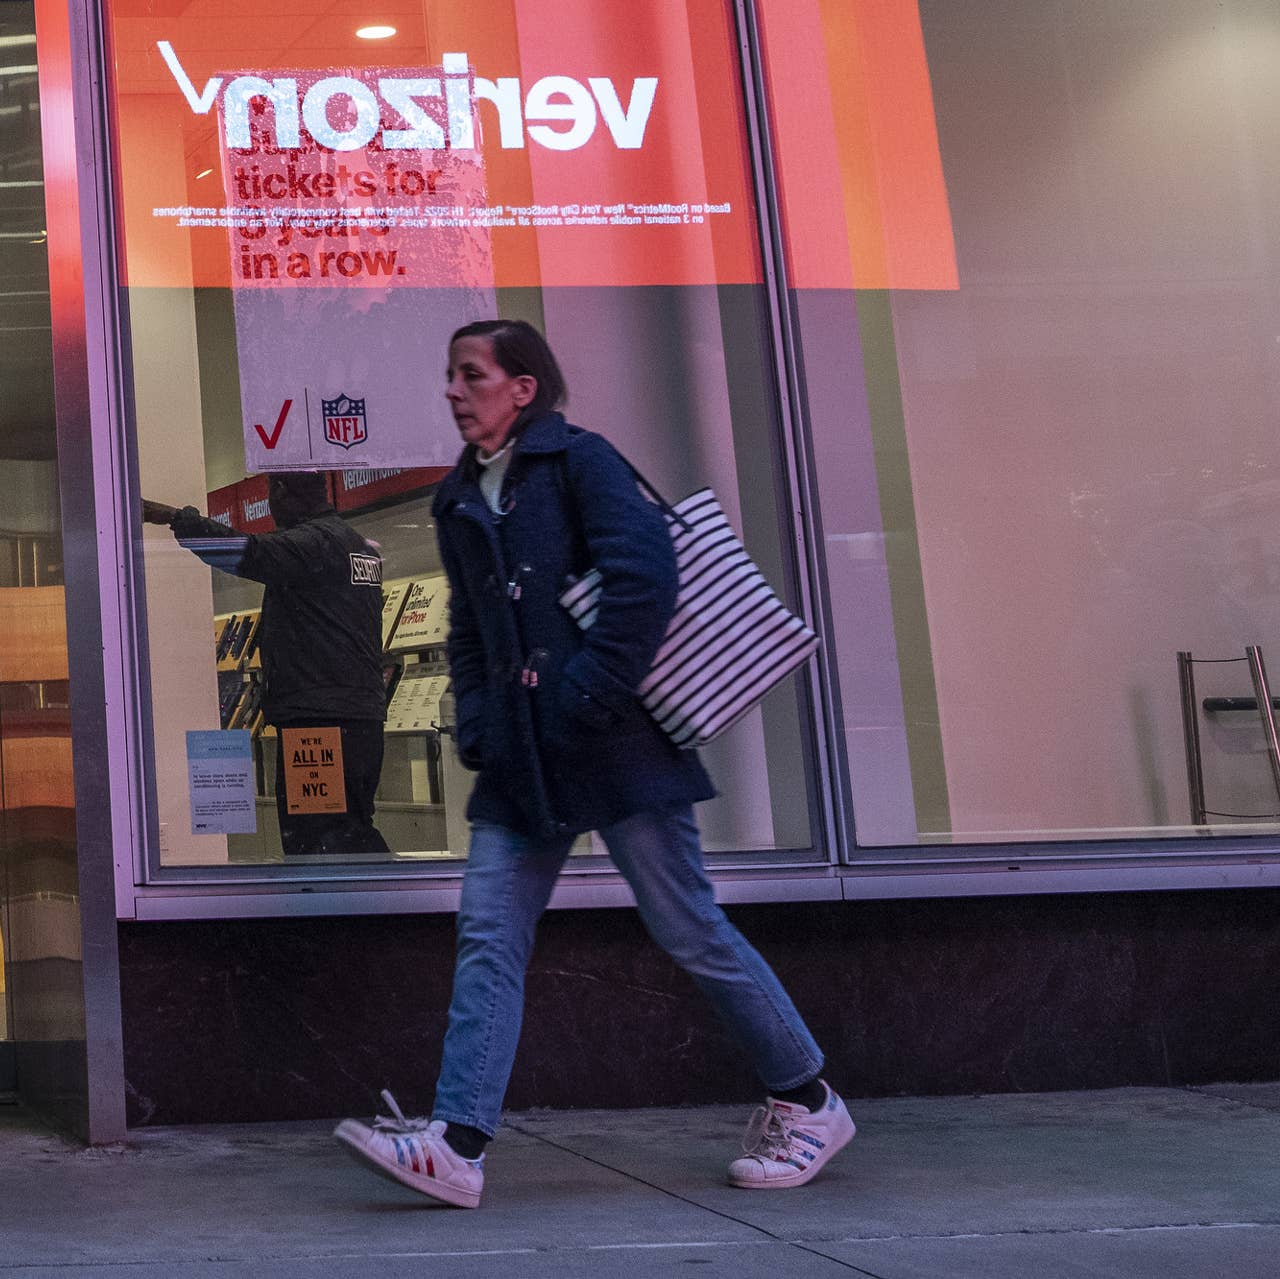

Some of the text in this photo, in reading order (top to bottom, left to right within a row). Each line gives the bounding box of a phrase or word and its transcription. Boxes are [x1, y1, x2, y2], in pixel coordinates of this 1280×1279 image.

[234, 162, 442, 200] tickets for
[241, 245, 406, 279] in a row.
[327, 417, 364, 443] NFL
[293, 749, 334, 763] ALL IN
[309, 771, 319, 779] ON
[302, 783, 328, 797] NYC
